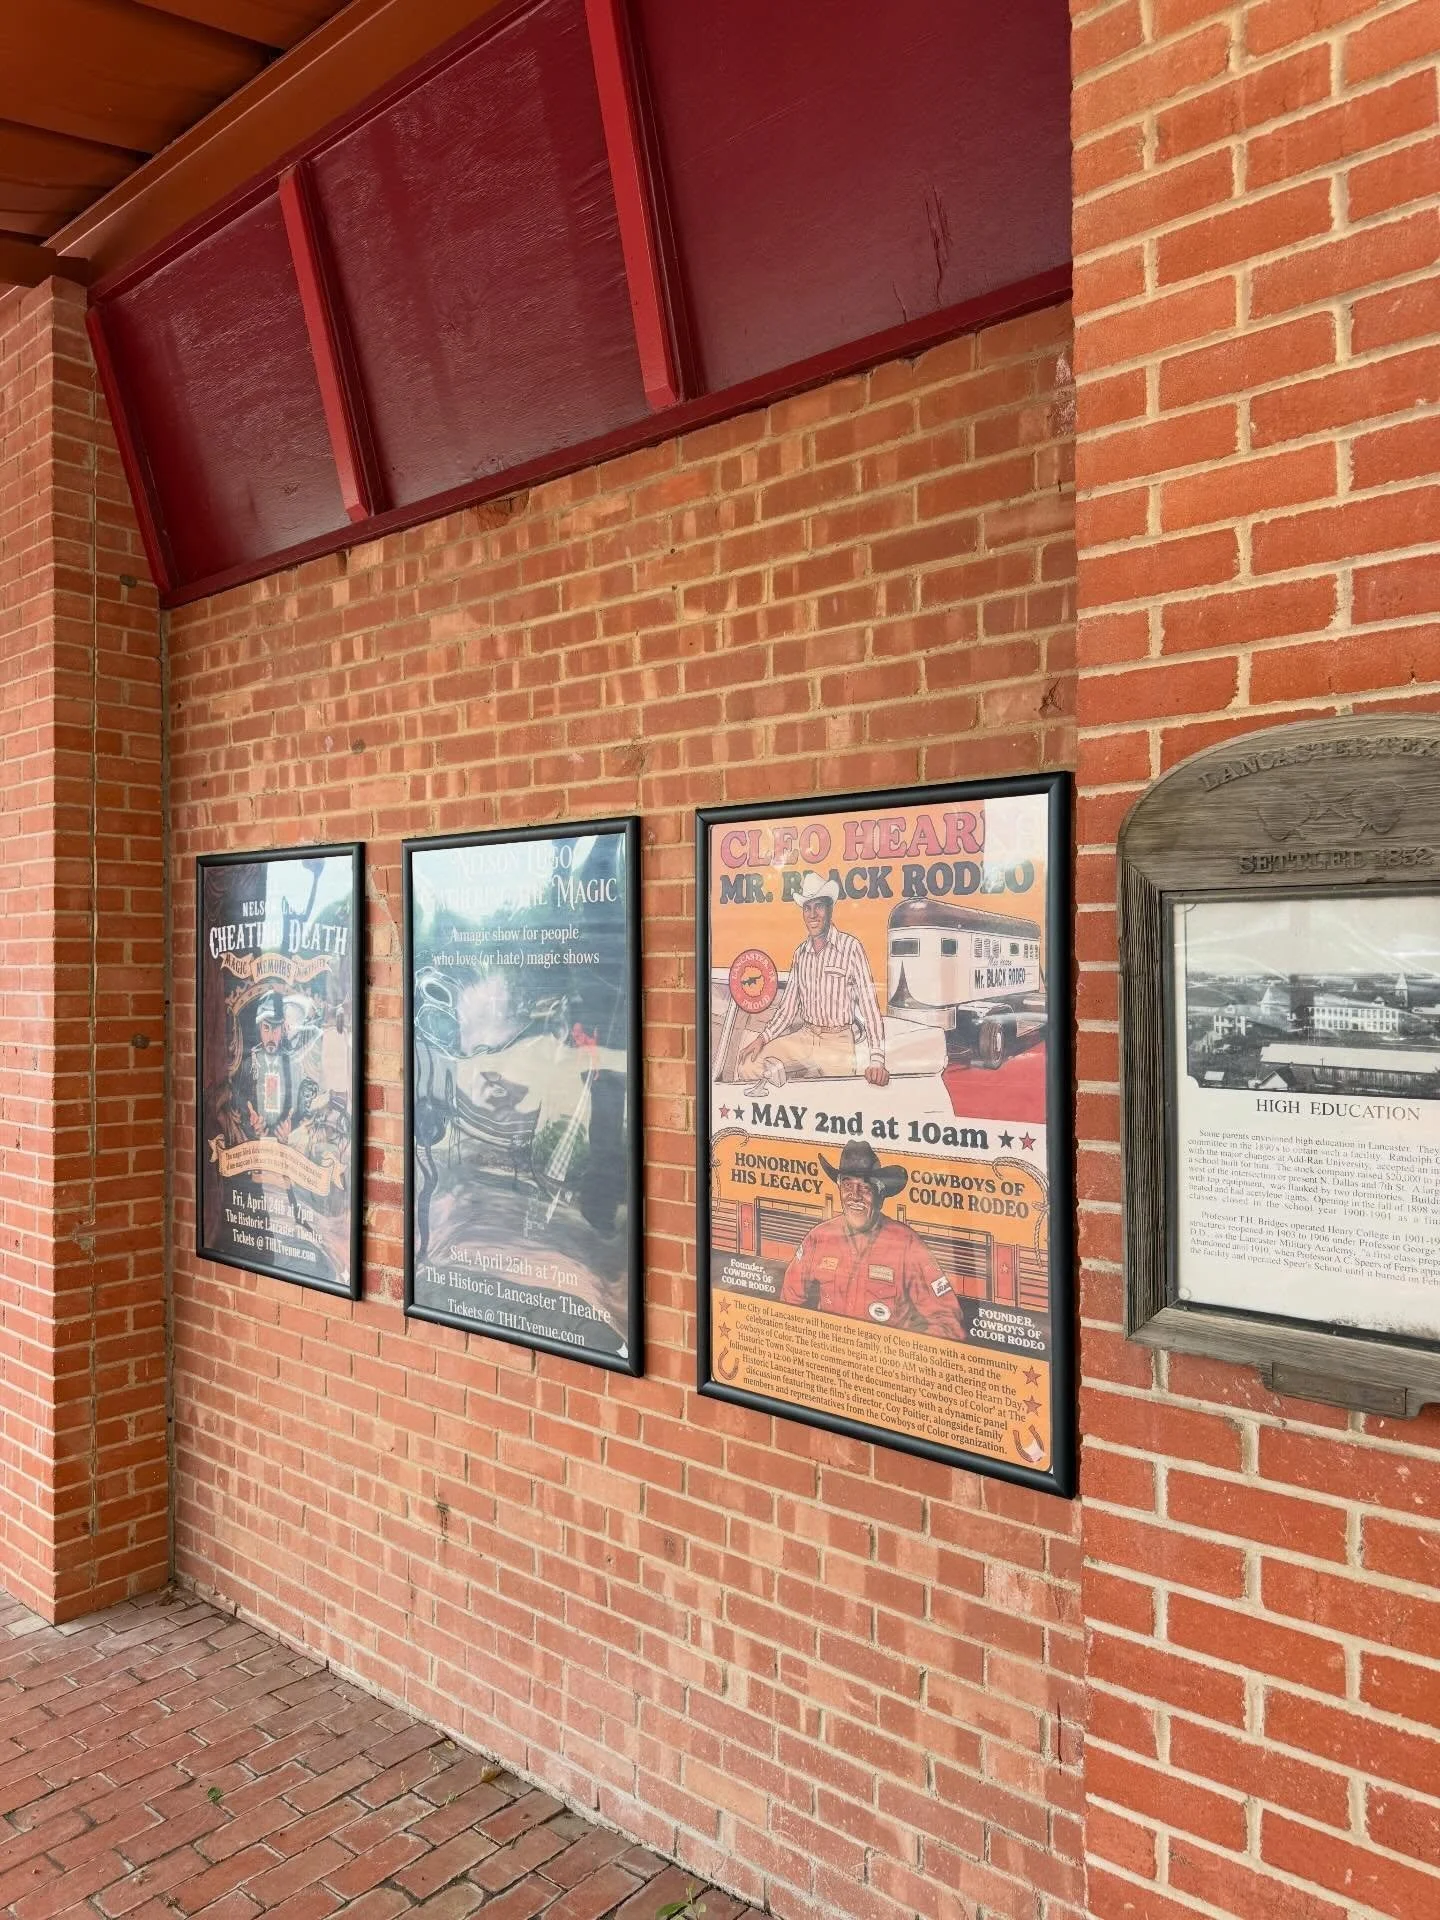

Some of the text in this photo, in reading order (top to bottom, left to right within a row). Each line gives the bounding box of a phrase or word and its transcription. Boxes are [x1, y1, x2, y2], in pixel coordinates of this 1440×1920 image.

[721, 809, 988, 869] CLEO HEAR
[1239, 846, 1434, 874] SETTLED 1852
[553, 875, 617, 910] MAGIC
[720, 860, 1035, 904] MR. BACK RODEO
[458, 926, 489, 945] magic
[492, 925, 520, 941] show
[523, 925, 538, 940] for
[541, 924, 580, 944] people
[256, 960, 291, 977] MEMOIRS
[432, 951, 454, 966] who
[456, 951, 479, 966] love
[497, 949, 525, 968] hate)
[527, 950, 561, 968] magic
[563, 949, 600, 964] shows
[975, 967, 1025, 989] Mr. BLACK RODEO
[1256, 1099, 1421, 1120] HIGH EDUCATION
[751, 1103, 989, 1150] MAY 2nd at 10am
[734, 1152, 819, 1176] HONORING
[731, 1169, 823, 1195] HIS LEGACY
[910, 1170, 1025, 1196] COWBOYS OF
[232, 1190, 245, 1209] Fri,
[247, 1192, 267, 1212] April
[297, 1203, 314, 1222] 7pm
[908, 1187, 1029, 1219] COLOR RODEO
[225, 1209, 238, 1225] The
[238, 1211, 264, 1231] Historic
[233, 1229, 254, 1247] Tickets
[256, 1236, 264, 1250] @
[450, 1246, 578, 1288] Sat, April 25th at 7pm
[724, 1267, 774, 1283] COWBOYS OF
[730, 1259, 766, 1274] Founder,
[425, 1266, 611, 1324] The Historic Lancaster Theatre
[722, 1275, 776, 1294] COLOR RODEO
[448, 1298, 585, 1346] Tickets @ THLTvenue.com
[972, 1318, 1042, 1339] COWBOYS OF
[979, 1308, 1036, 1328] FOUNDER,
[733, 1299, 746, 1310] The
[747, 1302, 760, 1316] City
[762, 1306, 769, 1315] of
[770, 1308, 807, 1324] Lancaster
[807, 1316, 818, 1326] will
[820, 1319, 841, 1332] honor
[843, 1325, 855, 1335] the
[857, 1327, 881, 1344] legacy
[883, 1334, 891, 1343] of
[892, 1335, 910, 1347] Cleo
[912, 1339, 937, 1354] Hearn
[939, 1346, 958, 1358] with
[967, 1354, 1017, 1375] community
[745, 1314, 1000, 1380] celebration featuring the Hearn family, the Buffalo Soldiers, and the
[970, 1328, 1046, 1351] COLOR RODEO
[742, 1353, 768, 1368] Historic
[770, 1360, 804, 1377] Lancaster
[806, 1369, 836, 1386] Theatre.
[838, 1378, 852, 1390] The
[853, 1384, 876, 1396] event
[877, 1390, 915, 1406] concludes
[917, 1399, 935, 1411] with
[944, 1405, 981, 1423] dynamic
[983, 1417, 1007, 1430] panel
[745, 1365, 781, 1382] discussion
[782, 1374, 814, 1393] featuring
[816, 1384, 827, 1394] the
[851, 1392, 884, 1411] director,
[886, 1401, 900, 1416] Coy
[902, 1406, 932, 1423] Poitier,
[933, 1415, 973, 1433] alongside
[975, 1425, 1003, 1444] family
[743, 1377, 1007, 1454] members and representatives from the Cowboys of Color organization.
